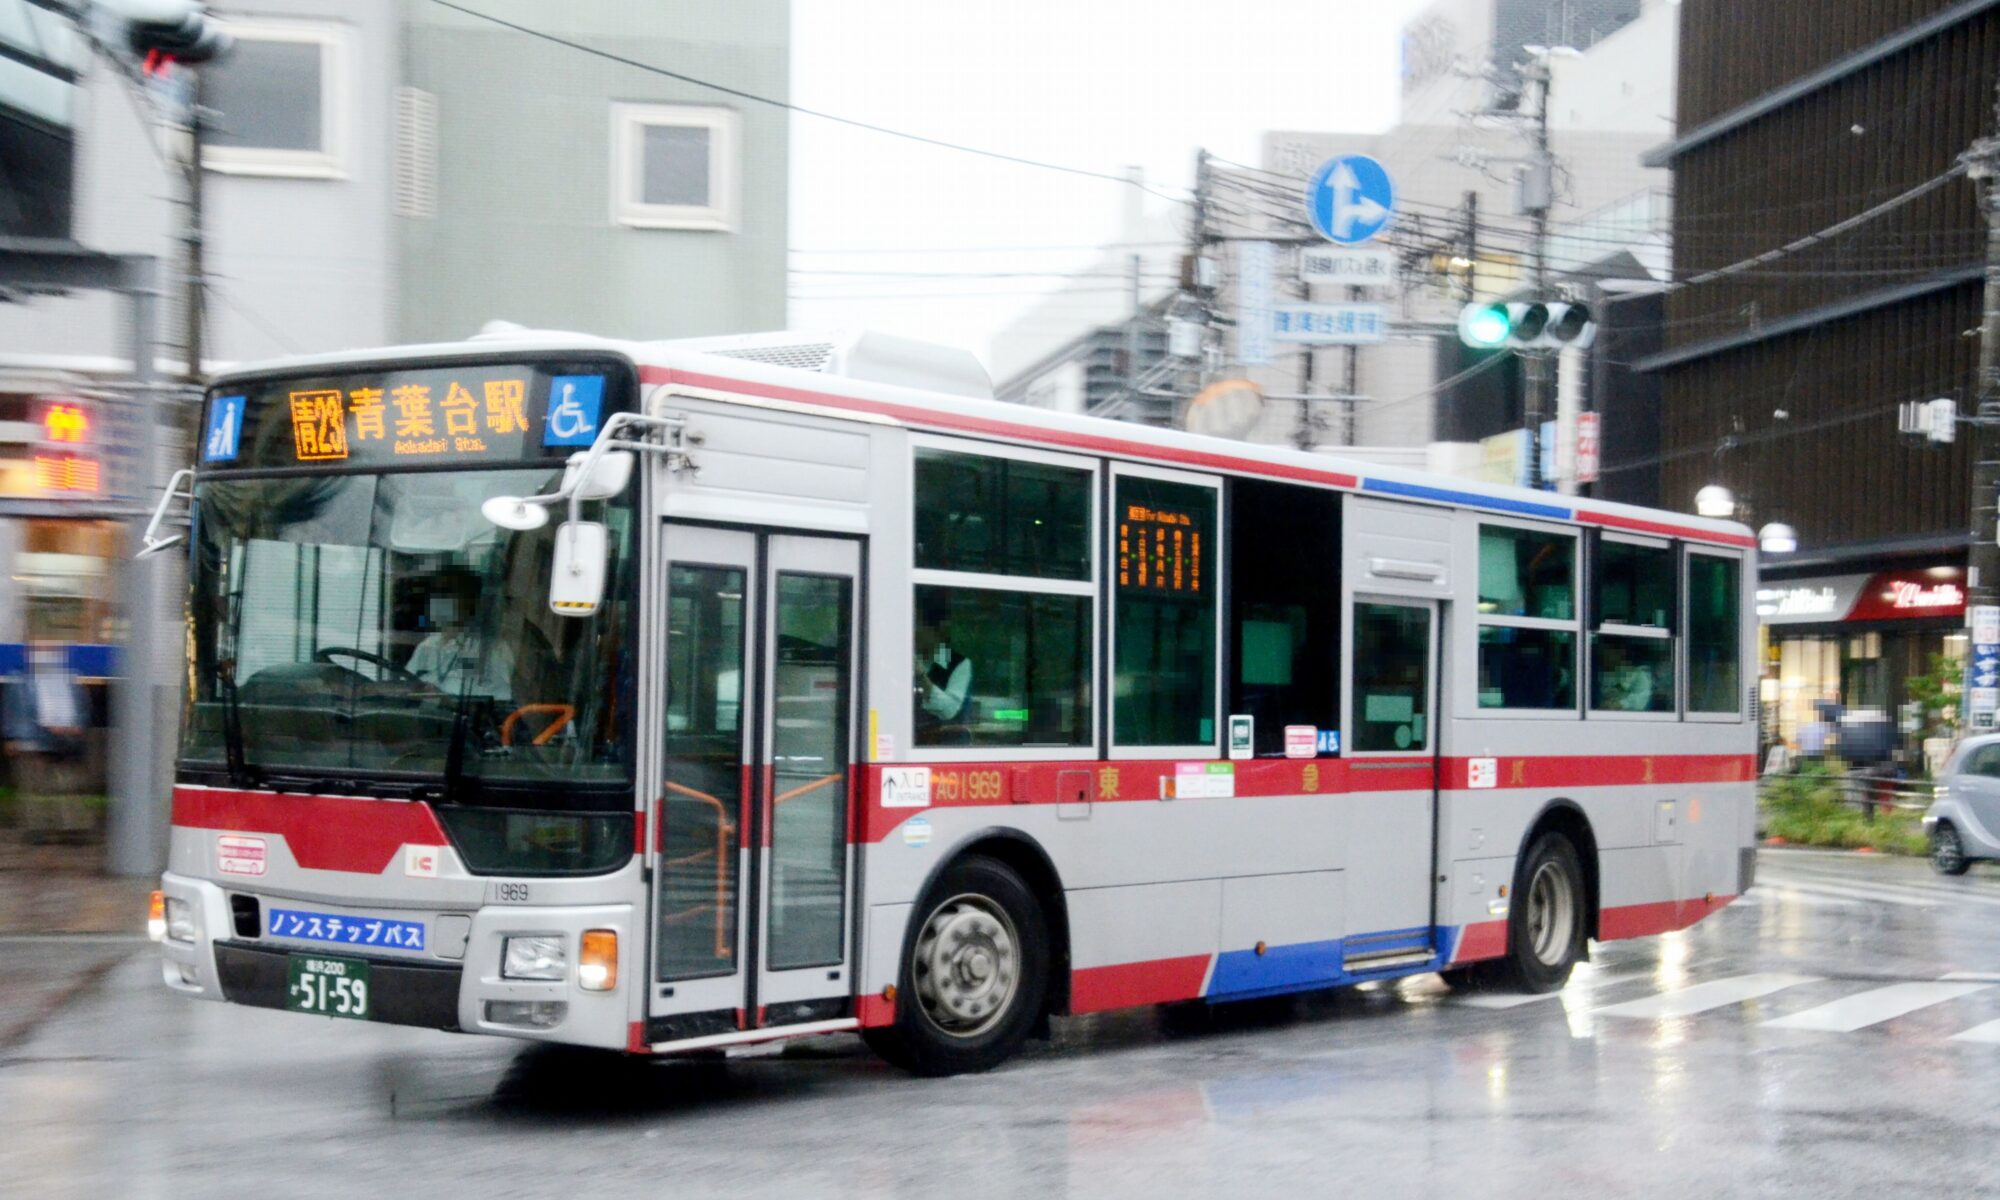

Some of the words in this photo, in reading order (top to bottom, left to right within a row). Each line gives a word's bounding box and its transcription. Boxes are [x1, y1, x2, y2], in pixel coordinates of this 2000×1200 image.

[349, 379, 529, 441] 青葉台駅
[900, 771, 925, 789] 入口
[1099, 765, 1120, 799] 東
[495, 882, 529, 901] 1969
[270, 913, 422, 948] ノンステップバス
[300, 972, 367, 1015] 51-59
